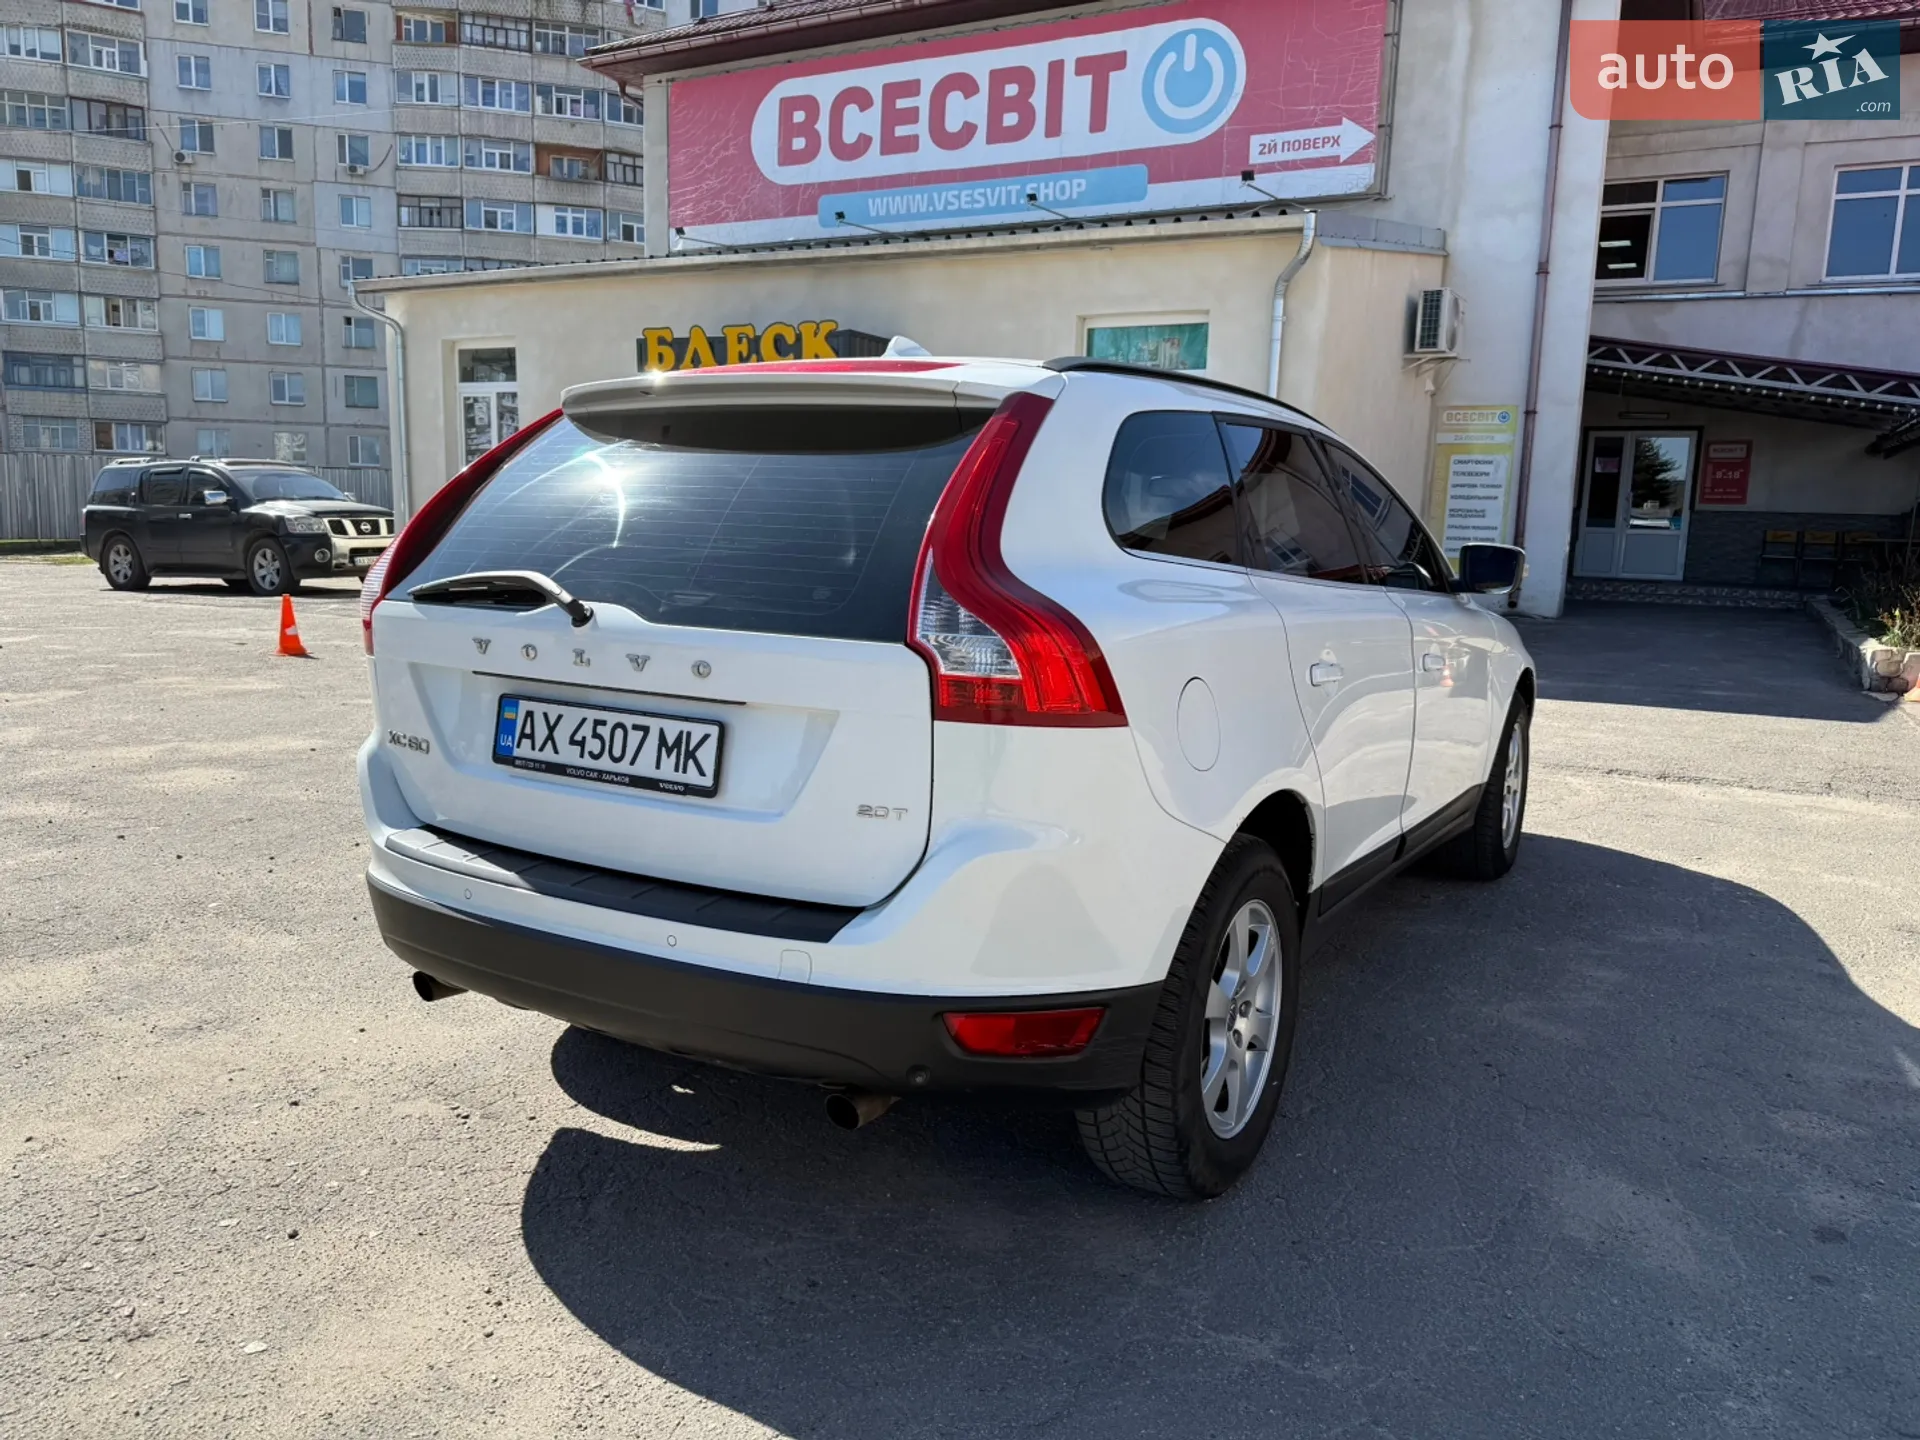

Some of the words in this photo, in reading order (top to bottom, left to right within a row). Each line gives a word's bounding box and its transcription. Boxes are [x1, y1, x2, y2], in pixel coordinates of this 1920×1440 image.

[777, 50, 1127, 168] ВСЕСВІТ
[1258, 138, 1278, 156] 2Й
[1281, 134, 1341, 153] ПОВЕРХ
[867, 177, 1087, 218] WWW.VSESVIT.SHOP
[642, 319, 839, 371] БЛЕСК
[472, 637, 712, 679] VOLVO
[500, 733, 513, 747] UA
[516, 709, 564, 755] AX
[568, 716, 651, 767] 4507
[655, 727, 712, 777] MK
[566, 767, 584, 777] VOLVO
[659, 782, 685, 792] VOLVO
